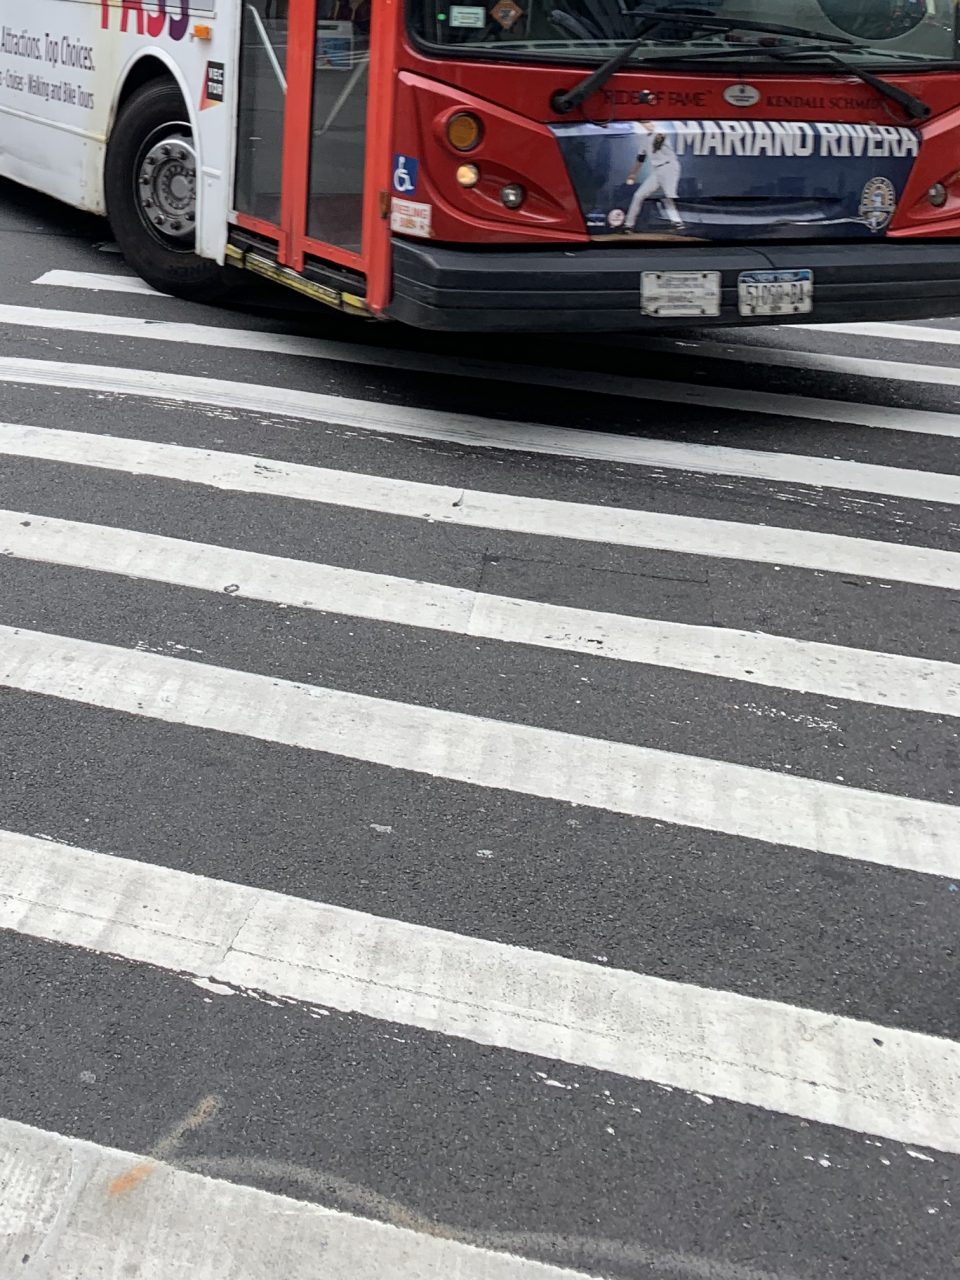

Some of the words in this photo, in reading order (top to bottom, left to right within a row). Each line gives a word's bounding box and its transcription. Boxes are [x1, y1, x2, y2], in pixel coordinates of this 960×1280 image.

[44, 32, 60, 68] Top
[60, 35, 96, 72] Choices.
[78, 84, 95, 110] Tours
[767, 96, 825, 108] KENDALL
[672, 120, 815, 157] MARIANO
[817, 122, 919, 158] RIVERA
